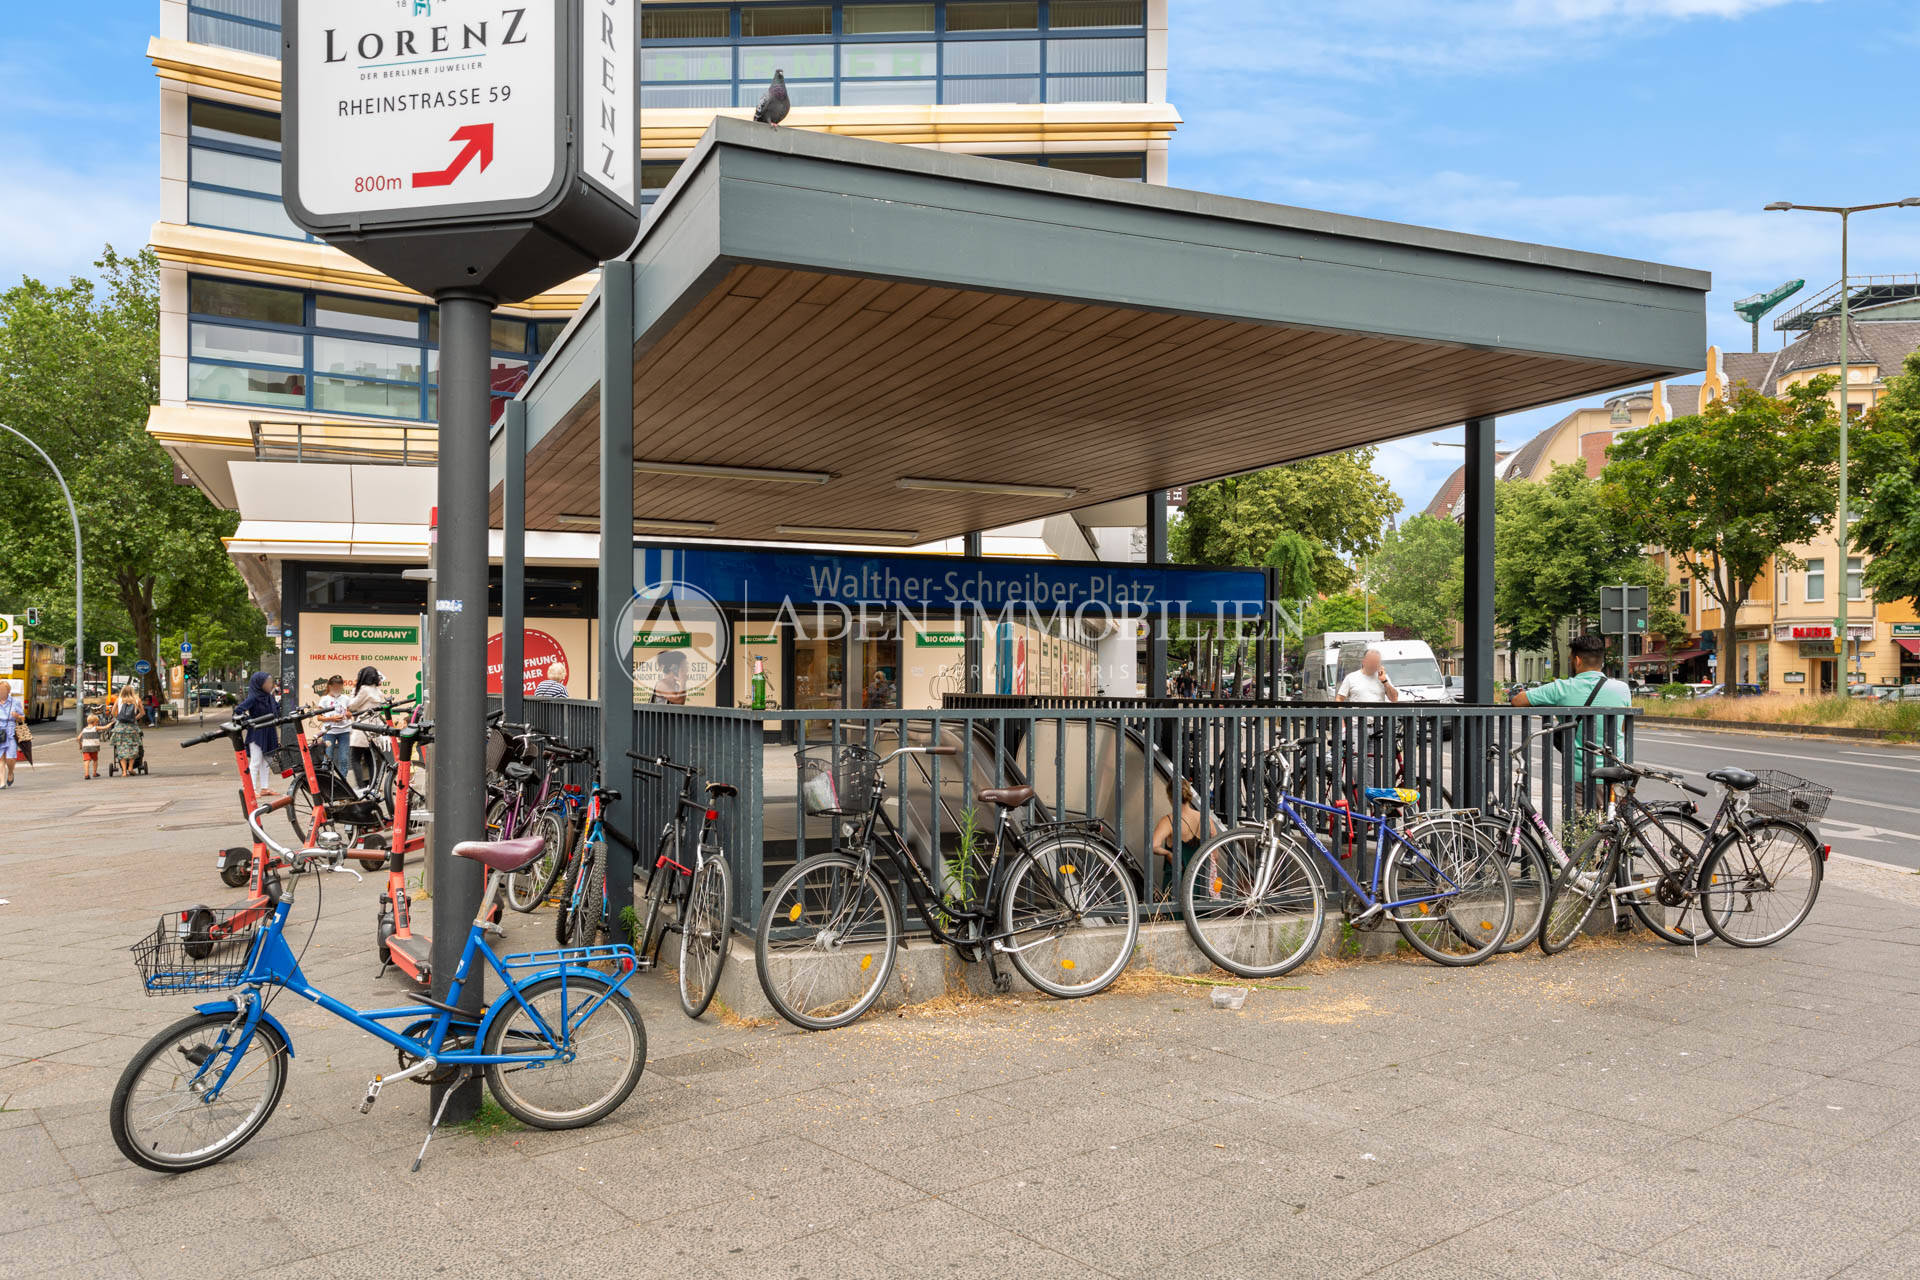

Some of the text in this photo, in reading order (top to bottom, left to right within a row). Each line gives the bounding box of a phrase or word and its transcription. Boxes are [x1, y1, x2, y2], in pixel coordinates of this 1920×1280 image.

[323, 8, 528, 64] LORENZ
[360, 61, 483, 81] DER BERLINER JUWELIER
[600, 0, 617, 181] RENZ
[338, 85, 512, 117] RHEINSTRASSE 59
[354, 175, 402, 193] 800m
[809, 564, 1156, 607] Walther-Schreiber-Platz
[342, 630, 408, 639] BIO COMPANY
[643, 635, 683, 644] COMPANY
[327, 653, 360, 661] NÄCHSTE
